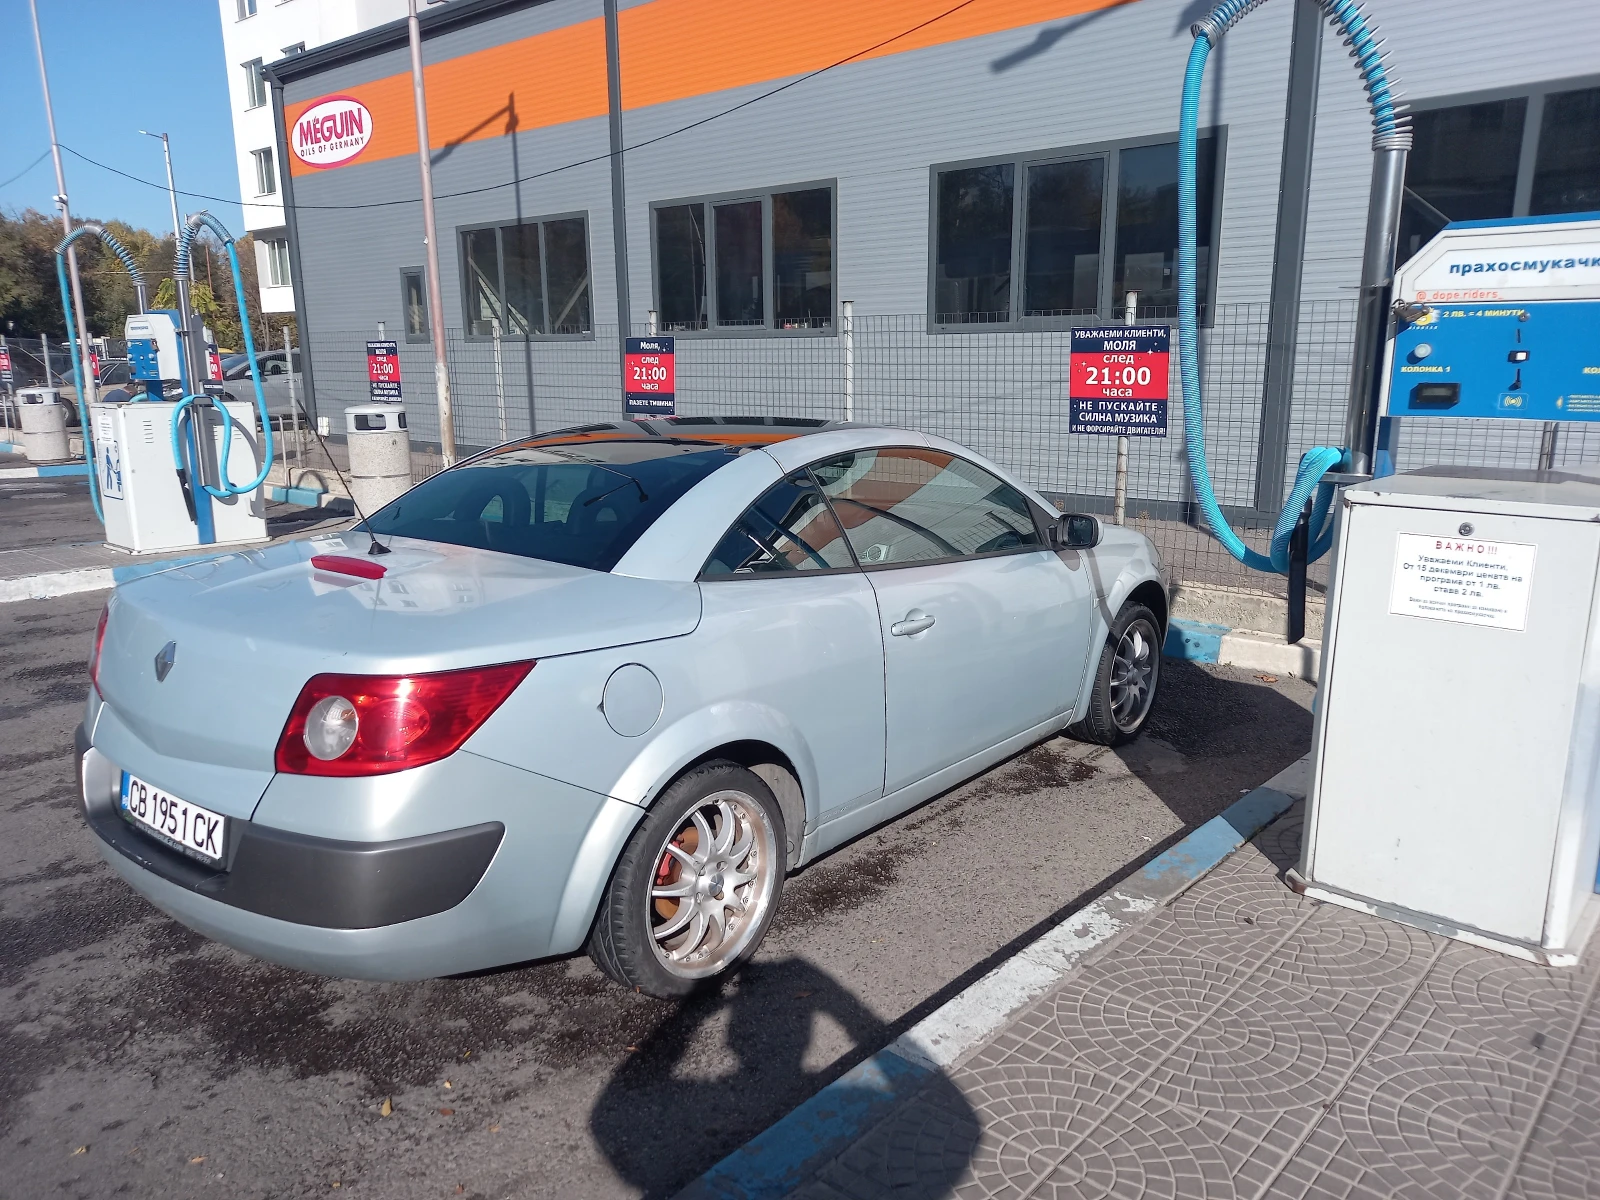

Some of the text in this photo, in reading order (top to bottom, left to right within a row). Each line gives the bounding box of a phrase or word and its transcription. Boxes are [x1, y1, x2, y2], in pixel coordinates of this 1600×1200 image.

[301, 136, 364, 157] OILS OF GERMANY
[1443, 310, 1450, 318] 2
[1075, 328, 1166, 338] УВАЖАЕМИ КЛИЕНТИ,
[640, 341, 660, 351] Моля,
[1103, 340, 1136, 350] МОЛЯ
[641, 356, 659, 364] след
[1103, 354, 1134, 364] след
[372, 363, 393, 374] 21:00
[633, 366, 667, 380] 21:00
[1085, 366, 1151, 385] 21:00
[1102, 388, 1133, 397] часа
[1079, 401, 1158, 411] НЕ ПУСКАЙТЕ
[1079, 412, 1157, 423] СИЛНА МУЗИКА
[1078, 424, 1085, 432] НЕ
[1085, 424, 1126, 434] ФОРСИРАЙТЕ
[1127, 426, 1166, 435] ДВИГАТЕЛЯ!
[1418, 555, 1464, 566] Уважаеми
[1403, 562, 1414, 570] От
[1417, 564, 1427, 572] 15
[1428, 566, 1474, 577] декември
[1420, 575, 1463, 586] програма
[1433, 586, 1459, 594] става
[1461, 588, 1468, 596] 2
[130, 779, 147, 818] CB
[152, 792, 188, 841] 1951
[193, 812, 220, 855] CK
